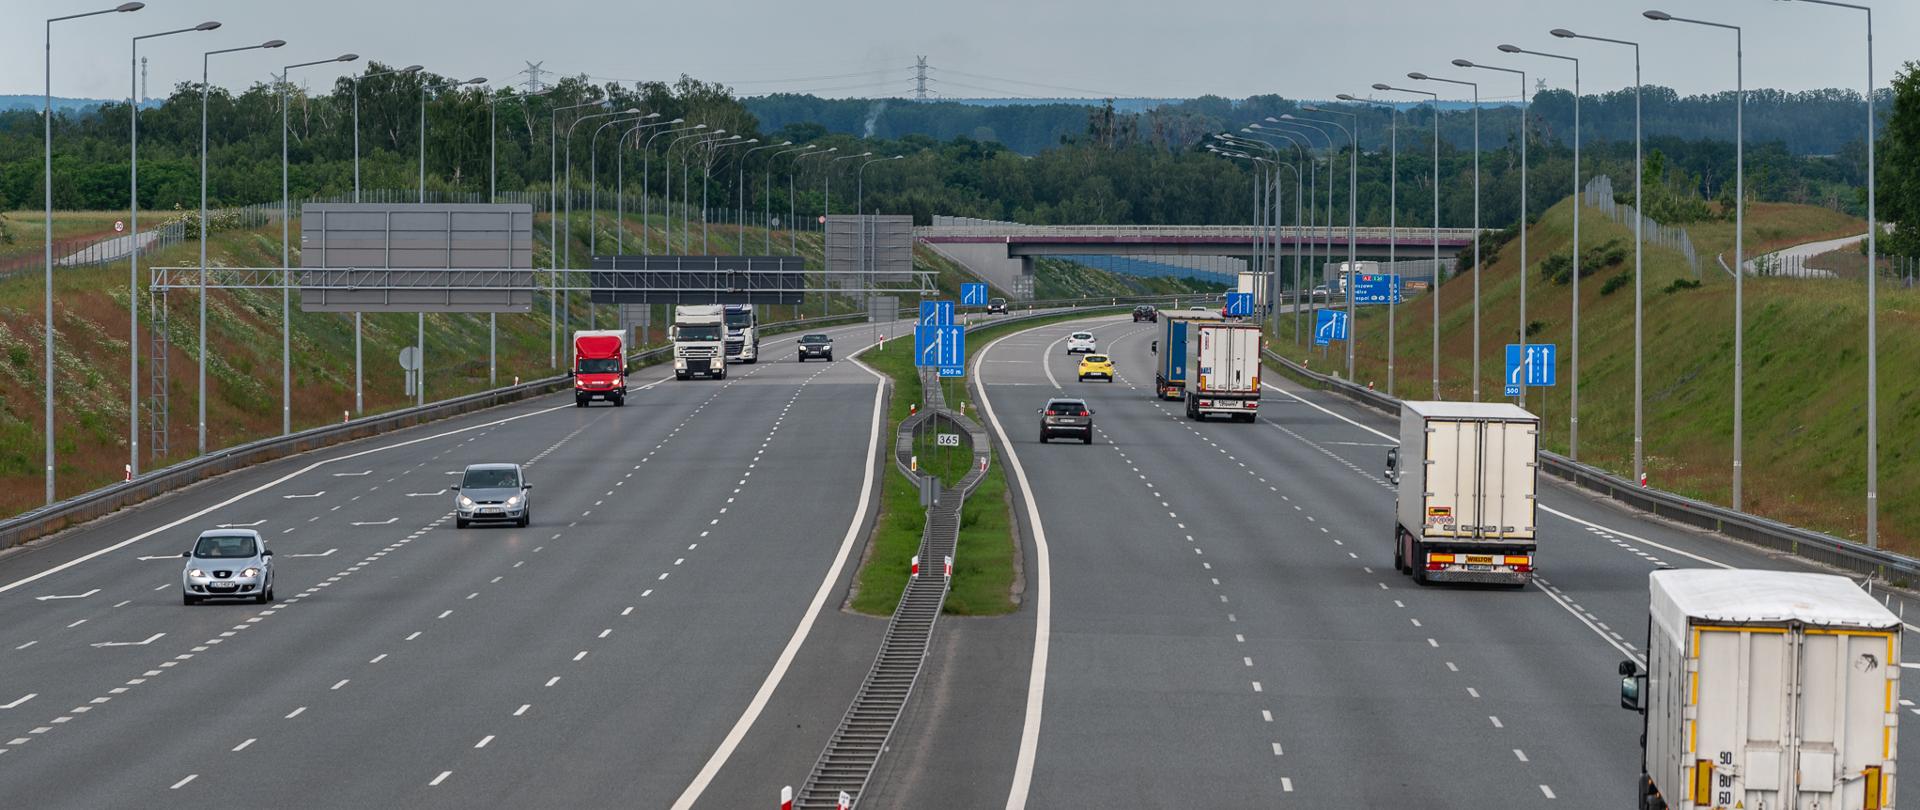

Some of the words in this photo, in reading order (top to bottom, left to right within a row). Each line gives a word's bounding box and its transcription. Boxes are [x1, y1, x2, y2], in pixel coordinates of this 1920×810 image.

[939, 436, 958, 444] 365
[1720, 752, 1731, 764] 90
[1719, 774, 1731, 787] 80
[1719, 791, 1731, 804] 60
